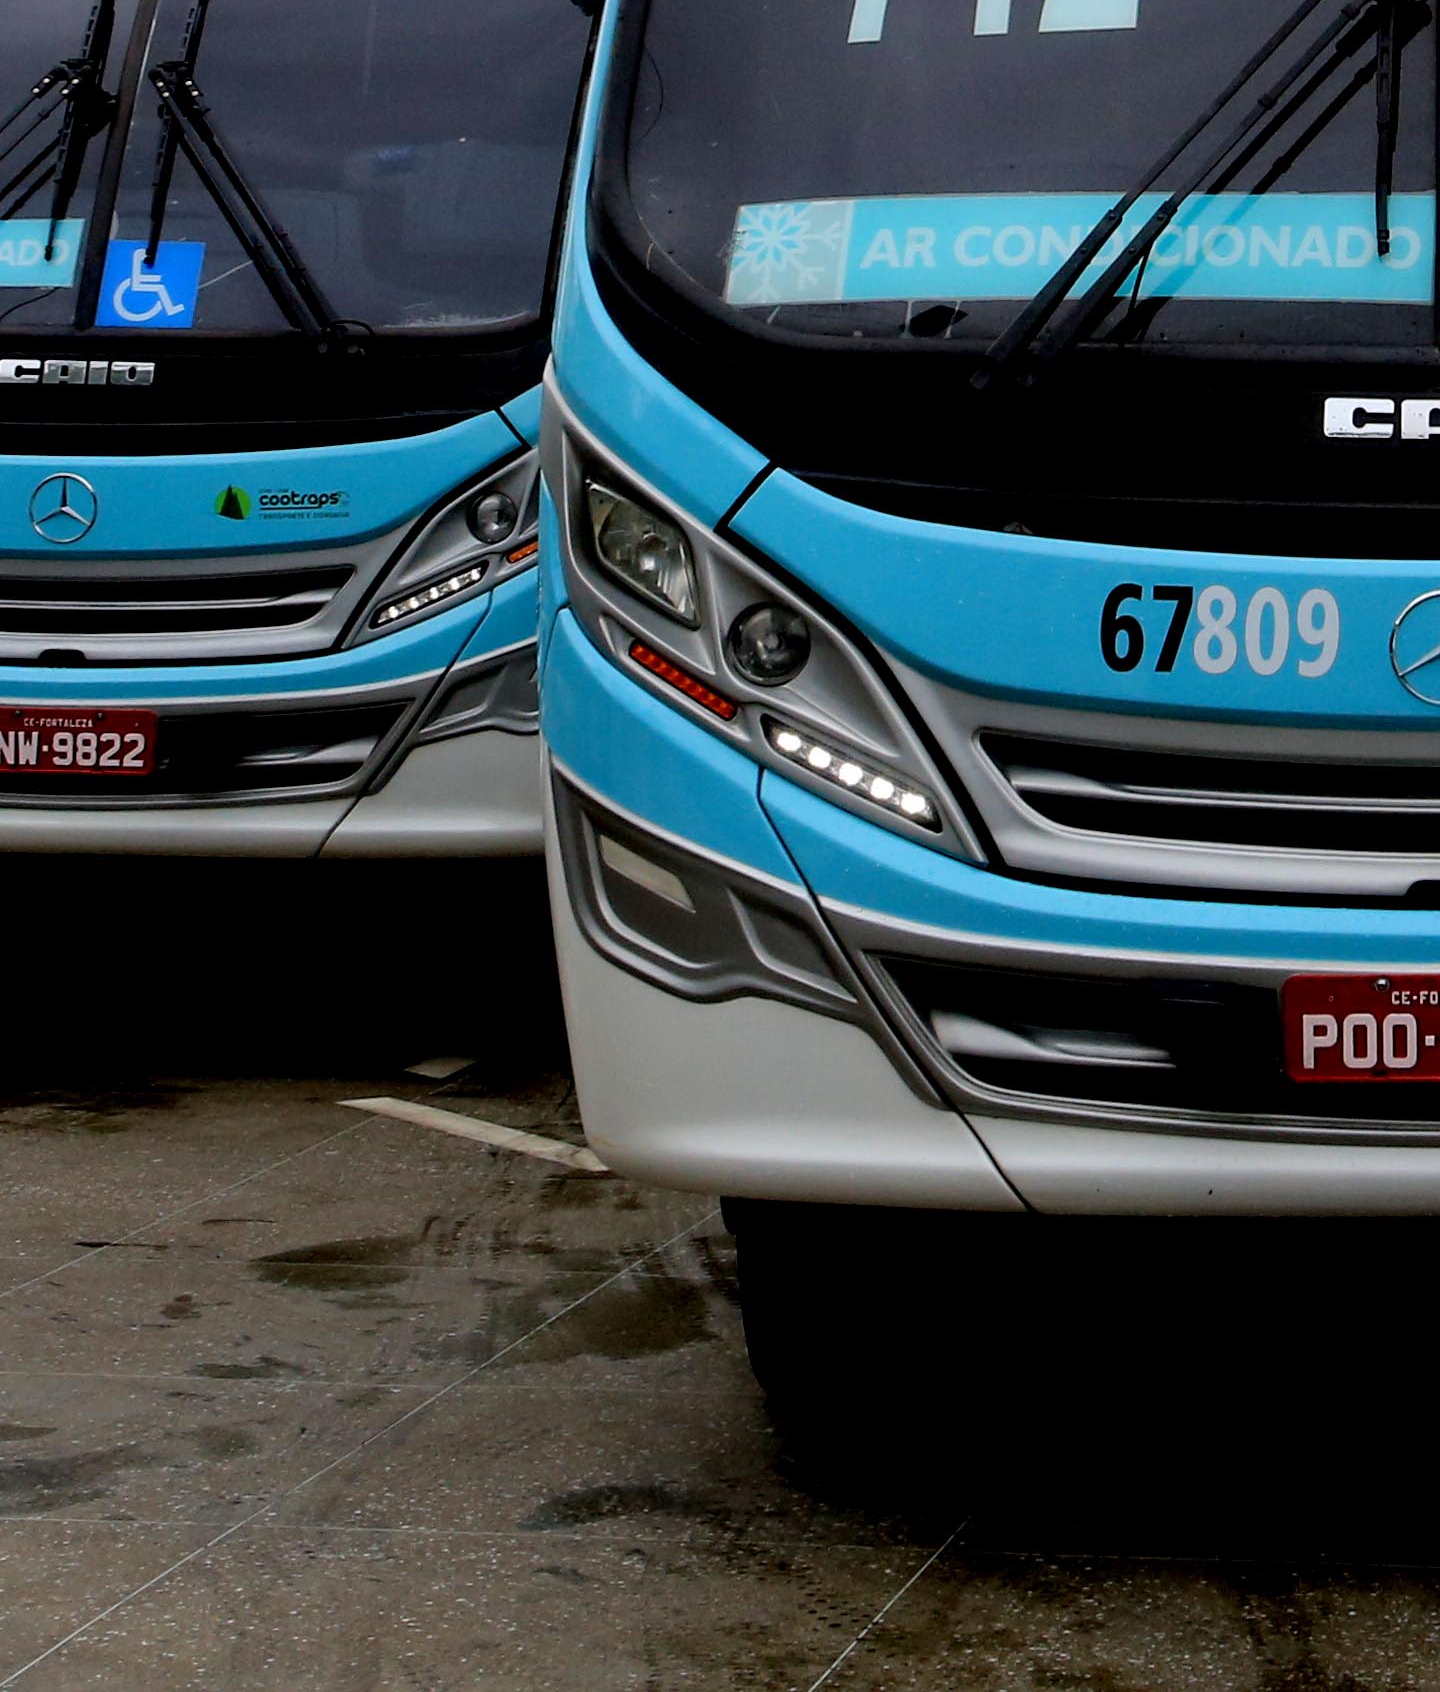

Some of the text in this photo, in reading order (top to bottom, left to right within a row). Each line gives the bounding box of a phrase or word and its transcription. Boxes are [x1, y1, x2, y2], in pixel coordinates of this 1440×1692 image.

[860, 227, 944, 269] AR
[259, 491, 339, 508] cootraps
[1098, 582, 1341, 678] 67809
